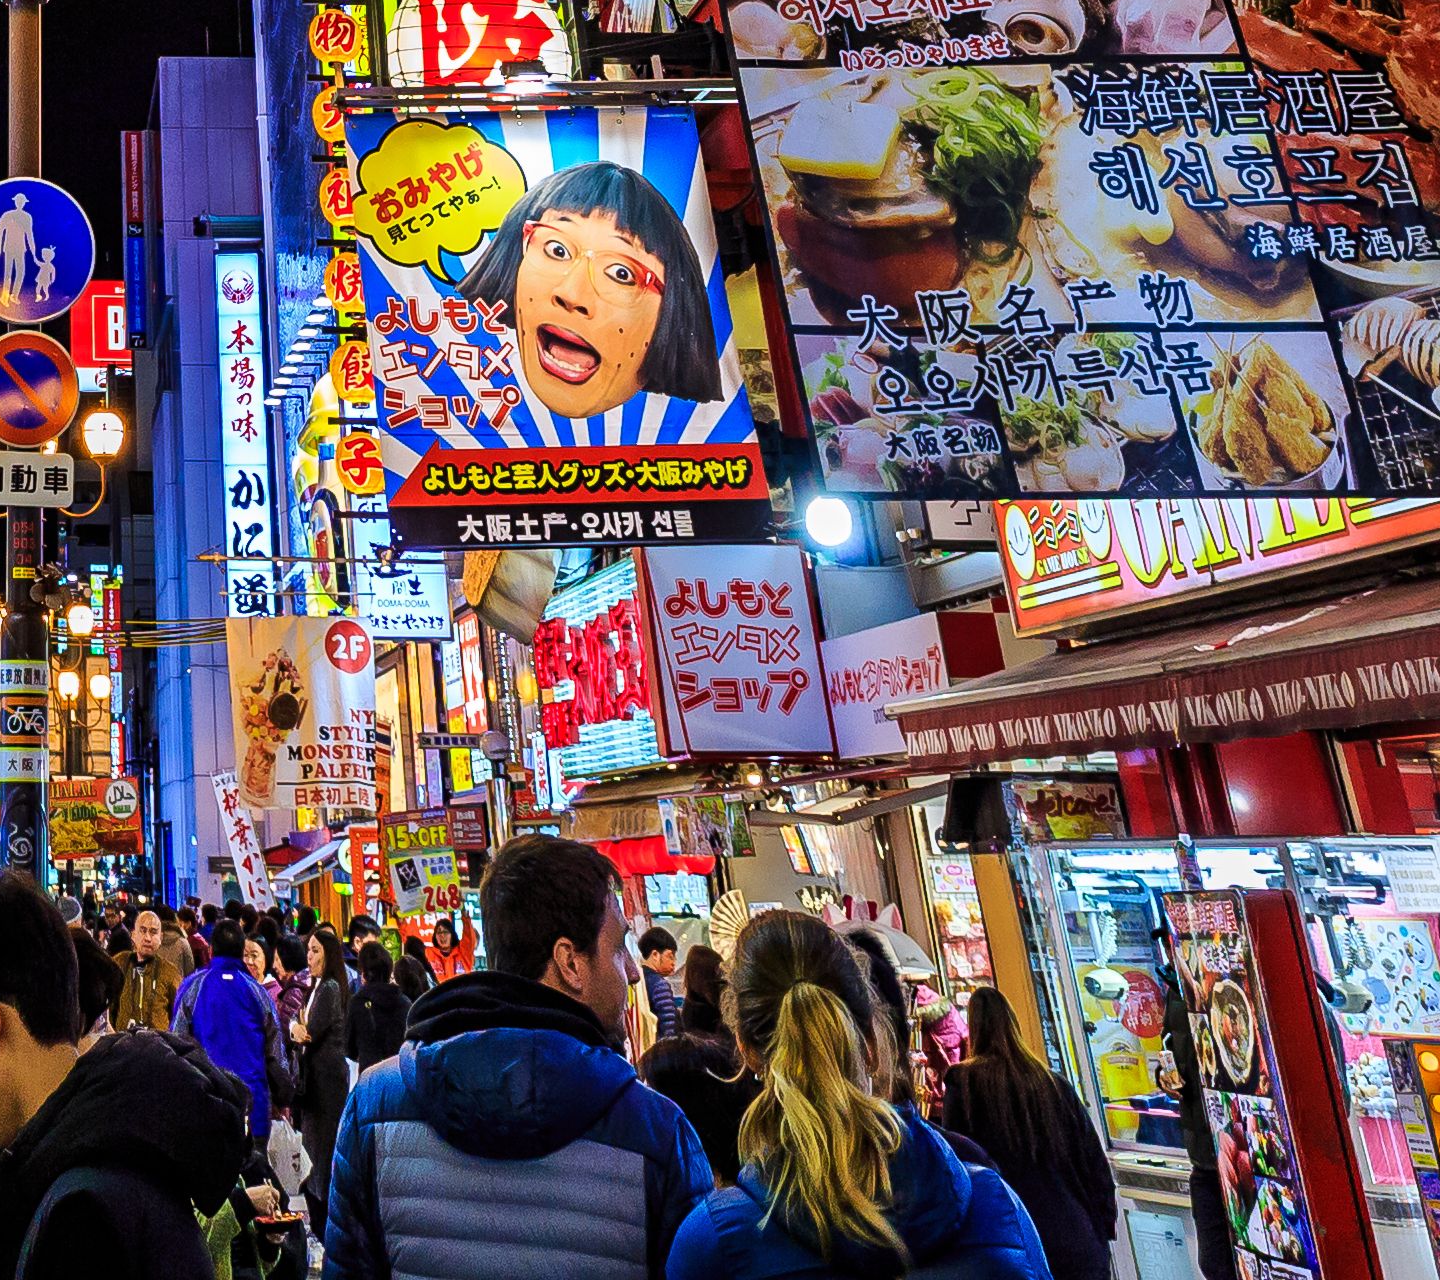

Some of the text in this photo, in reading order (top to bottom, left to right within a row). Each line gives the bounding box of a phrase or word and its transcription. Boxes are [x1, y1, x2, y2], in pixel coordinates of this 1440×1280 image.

[840, 35, 1008, 72] いらっしゃいませ
[369, 141, 484, 225] おみやげ
[1091, 140, 1421, 216] 해선호프집
[374, 297, 510, 334] よしもと
[381, 339, 515, 379] エンタメ
[226, 320, 258, 443] 本場の味
[383, 385, 520, 429] ショップ
[885, 425, 1000, 460] 大阪名物
[652, 509, 696, 538] 선물
[1028, 504, 1080, 547] ニコニコ
[1037, 551, 1090, 578] GAME HOUSE
[377, 599, 430, 608] DOMA-DOMA
[665, 579, 793, 618] よしもと
[332, 633, 367, 661] 2F
[672, 624, 801, 664] エンタメ
[676, 671, 809, 715] ショップ
[318, 725, 376, 742] STYLE
[350, 709, 375, 724] NY
[287, 744, 376, 762] MONSTER
[294, 786, 370, 806] 日本初上陸
[423, 883, 461, 911] 248
